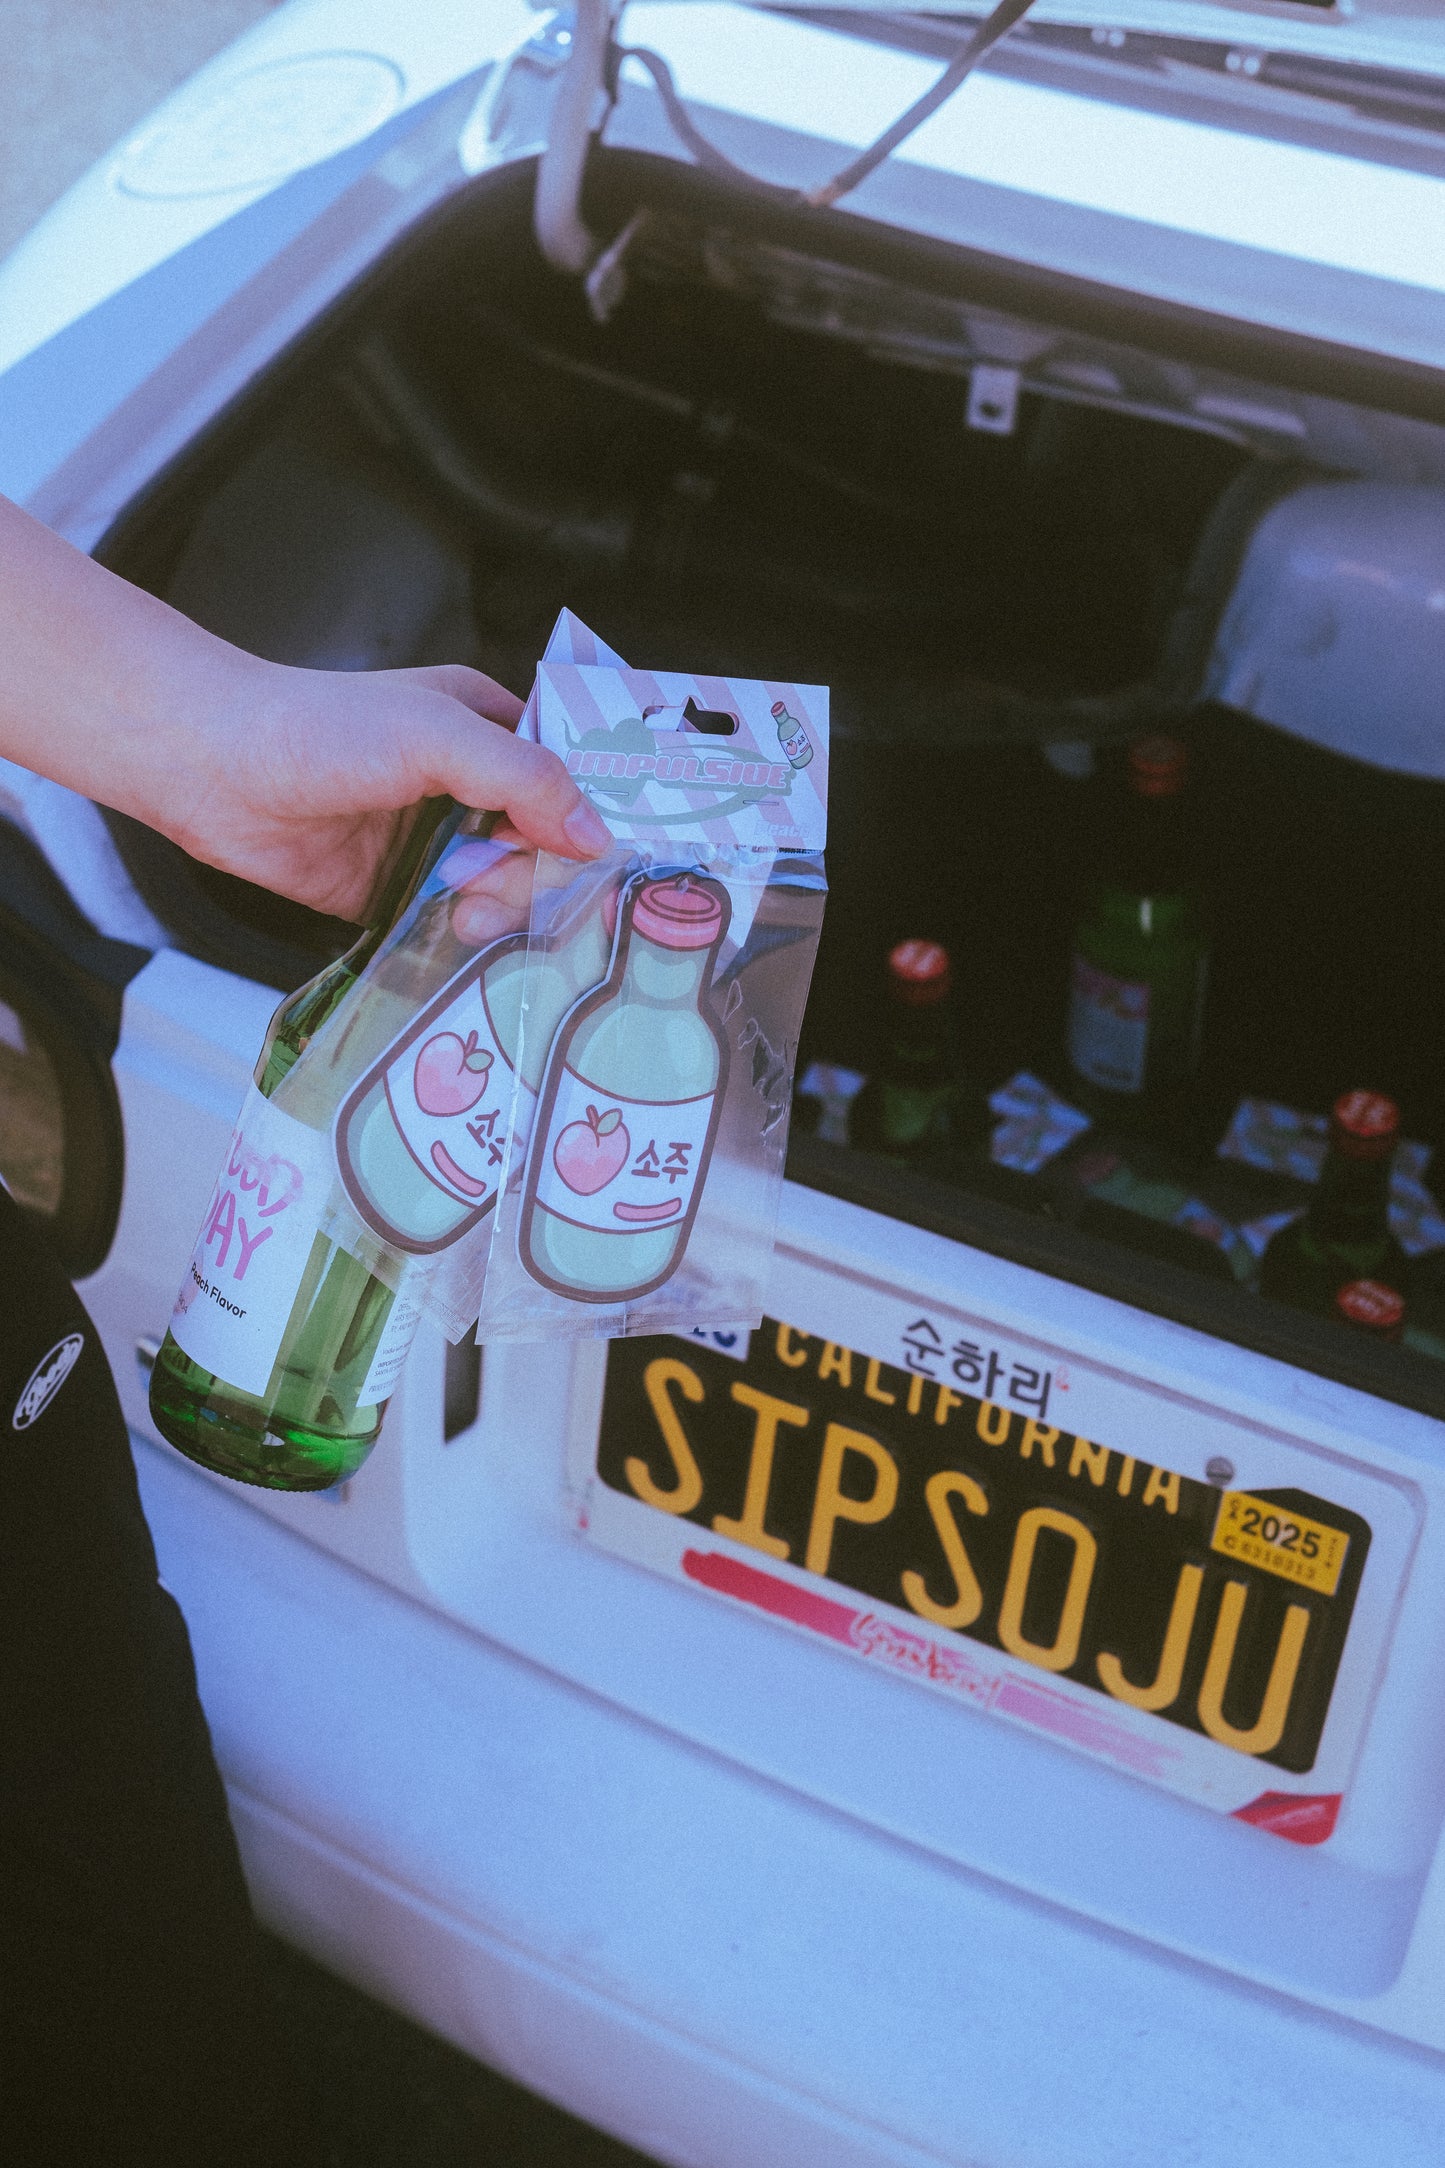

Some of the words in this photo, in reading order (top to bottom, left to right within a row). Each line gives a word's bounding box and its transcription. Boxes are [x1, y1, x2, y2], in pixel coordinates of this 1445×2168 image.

[564, 749, 791, 789] IMPULSIVE
[630, 1139, 693, 1184] 소주
[190, 1261, 210, 1294] Peach
[209, 1286, 247, 1319] Flavor
[902, 1318, 1052, 1420] 순하리
[776, 1321, 1181, 1515] CALIFORNIA
[624, 1357, 1311, 1755] SIPSOJU
[1241, 1508, 1322, 1559] 2025
